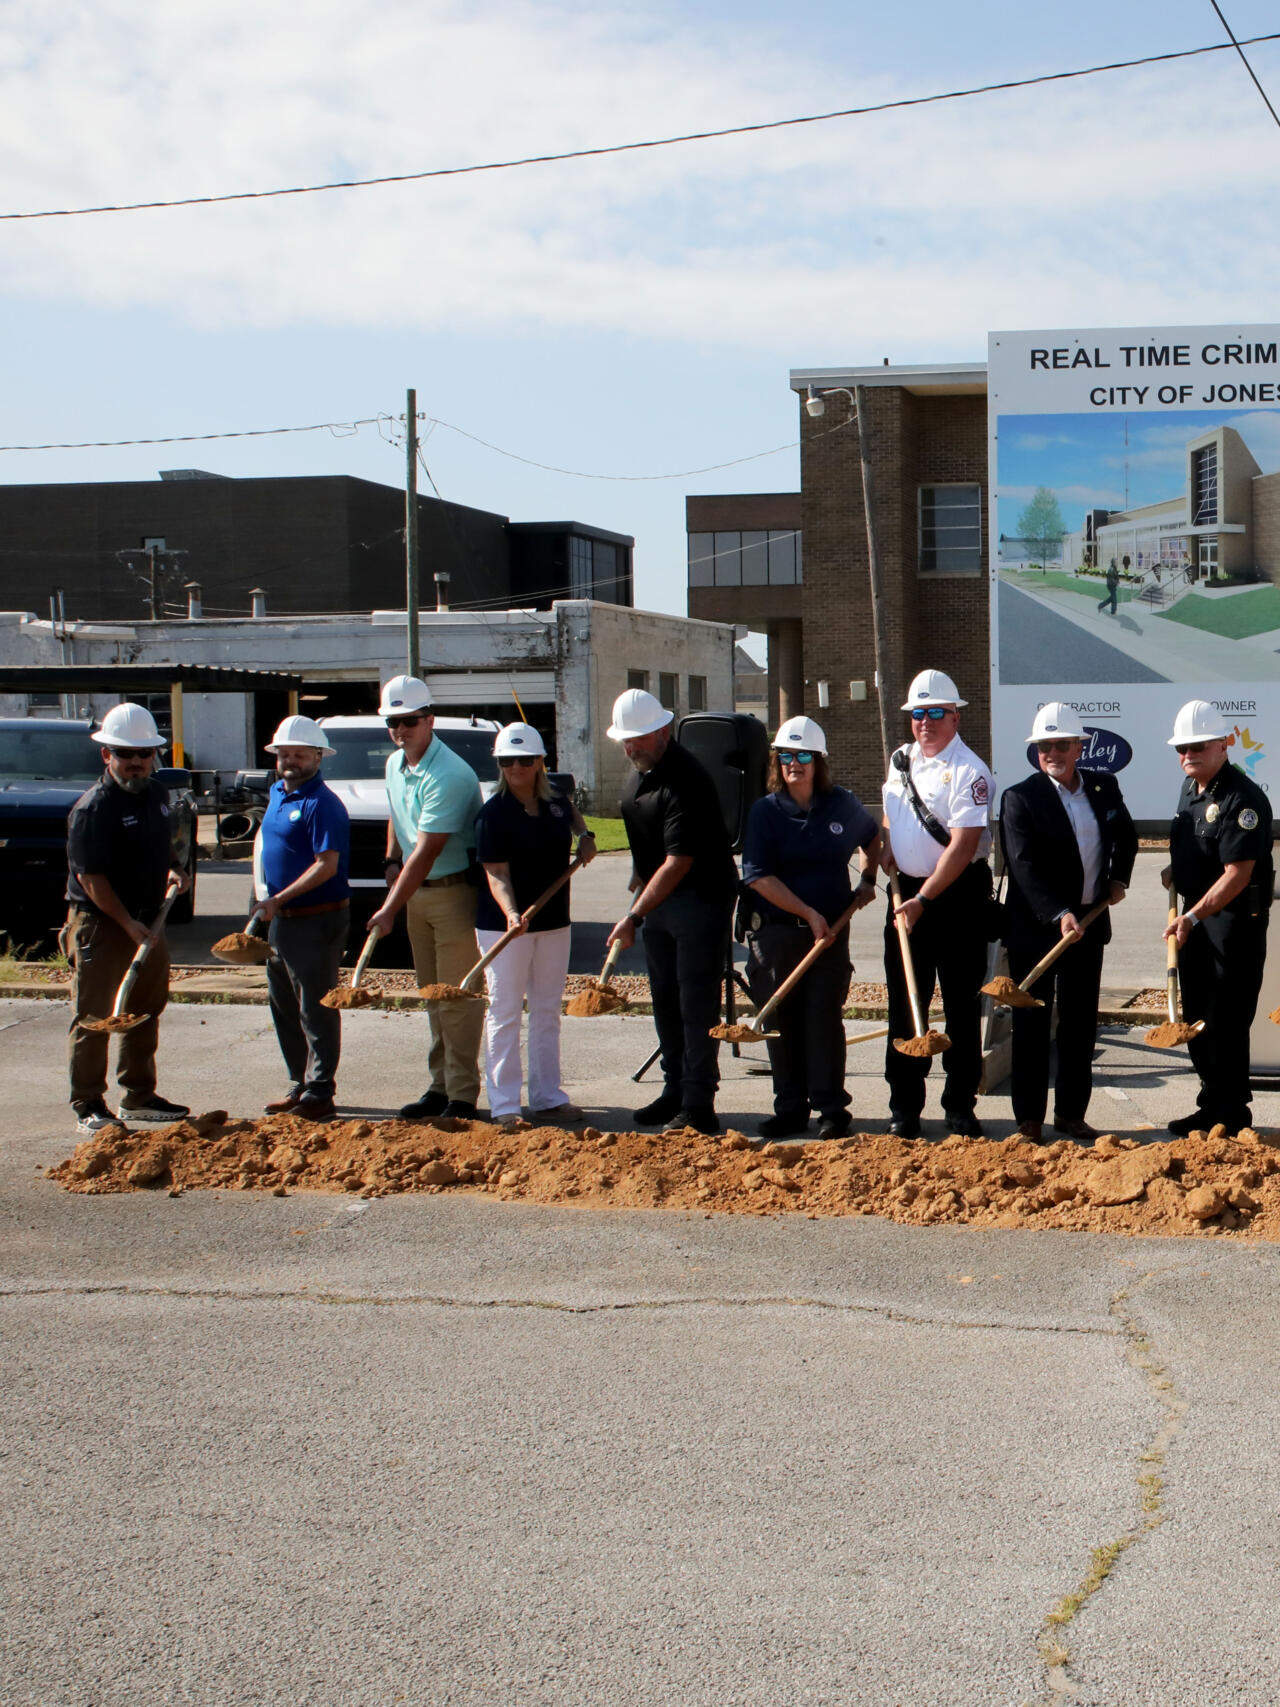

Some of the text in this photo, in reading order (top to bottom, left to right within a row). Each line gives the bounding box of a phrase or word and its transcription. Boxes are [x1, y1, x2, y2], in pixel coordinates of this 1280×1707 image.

[1030, 348, 1111, 369] REAL
[1119, 345, 1191, 367] TIME
[1089, 386, 1149, 406] CITY
[1157, 385, 1194, 404] OF
[1037, 702, 1120, 713] CRACTOR
[1210, 700, 1257, 711] OWNER
[1076, 731, 1117, 763] iley
